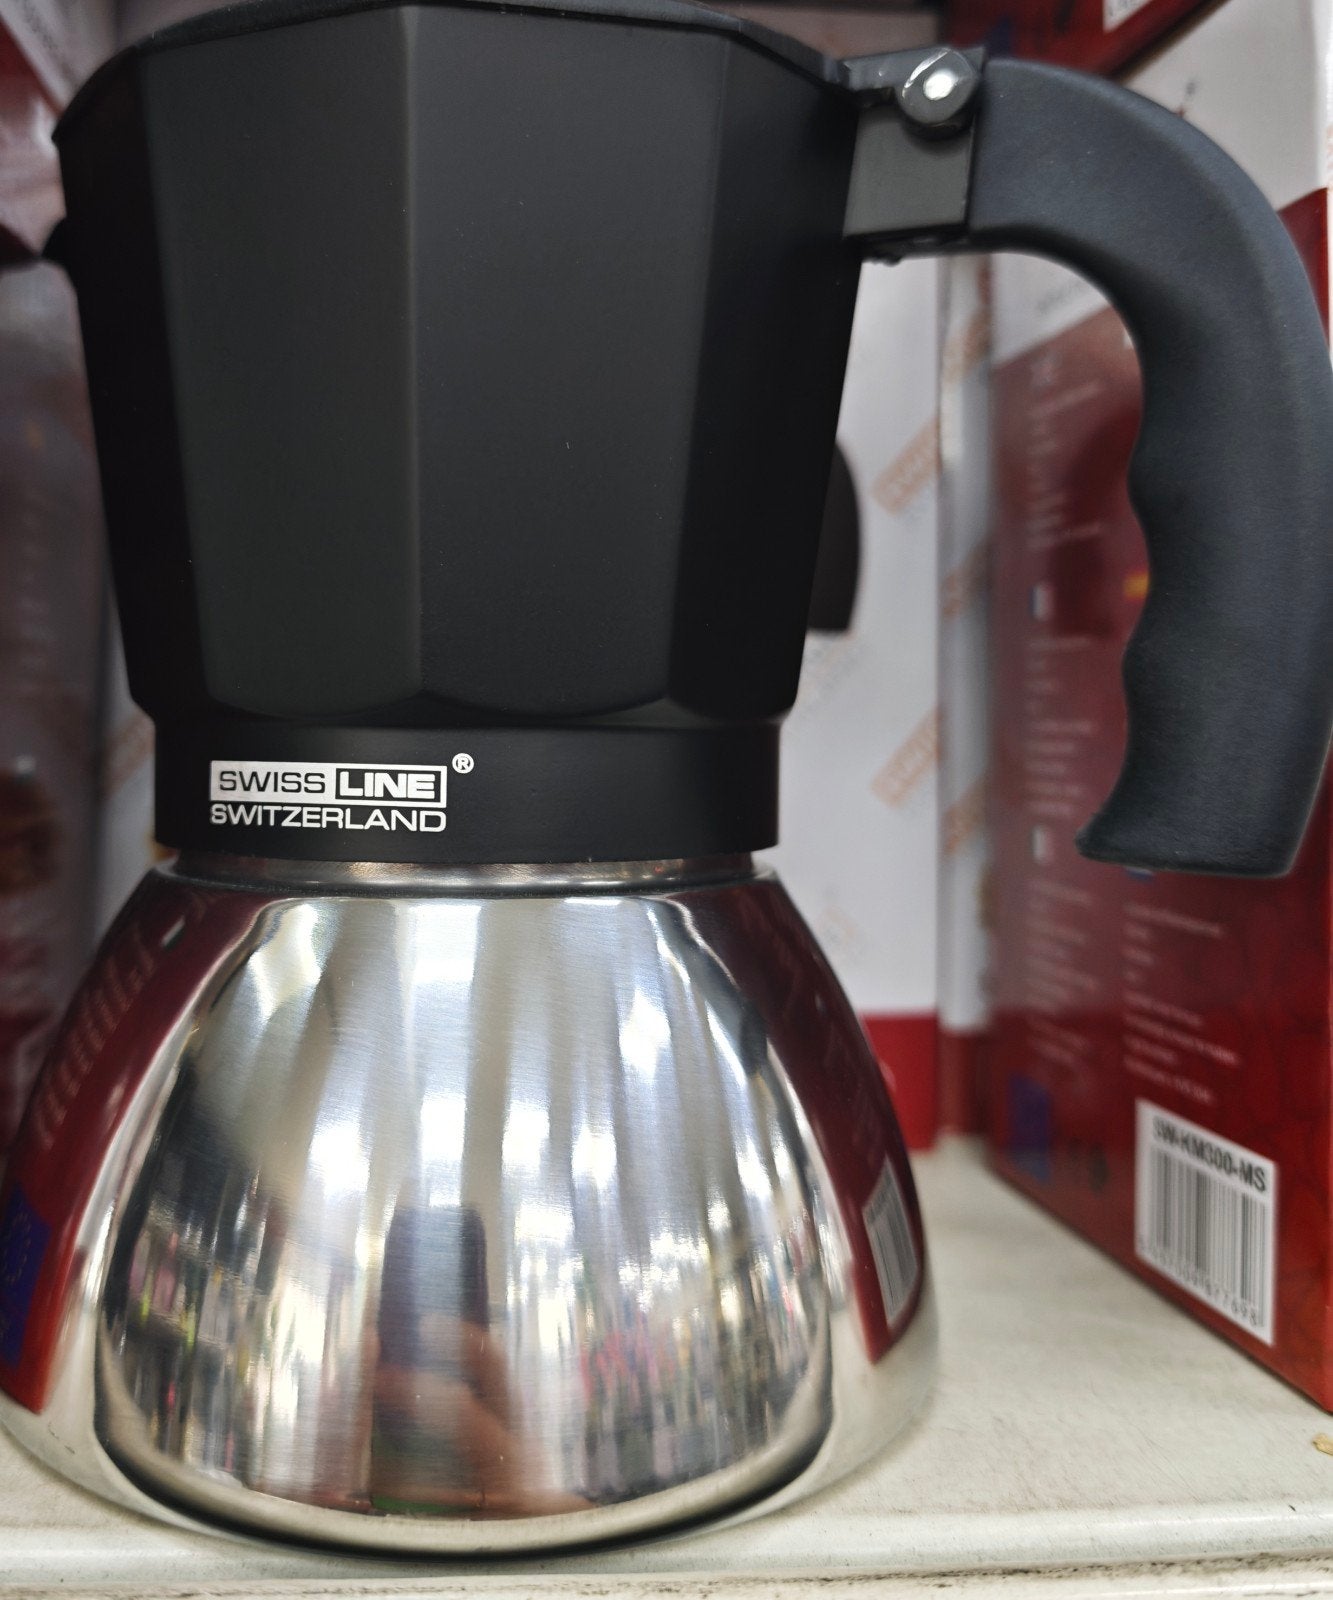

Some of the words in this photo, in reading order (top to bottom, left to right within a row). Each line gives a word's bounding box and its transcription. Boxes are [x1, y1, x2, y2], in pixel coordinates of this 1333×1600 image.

[219, 770, 326, 793] SWISS
[339, 771, 436, 799] LINE
[210, 803, 447, 832] SWITZERLAND
[1153, 1116, 1266, 1192] SW-KM300-MS
